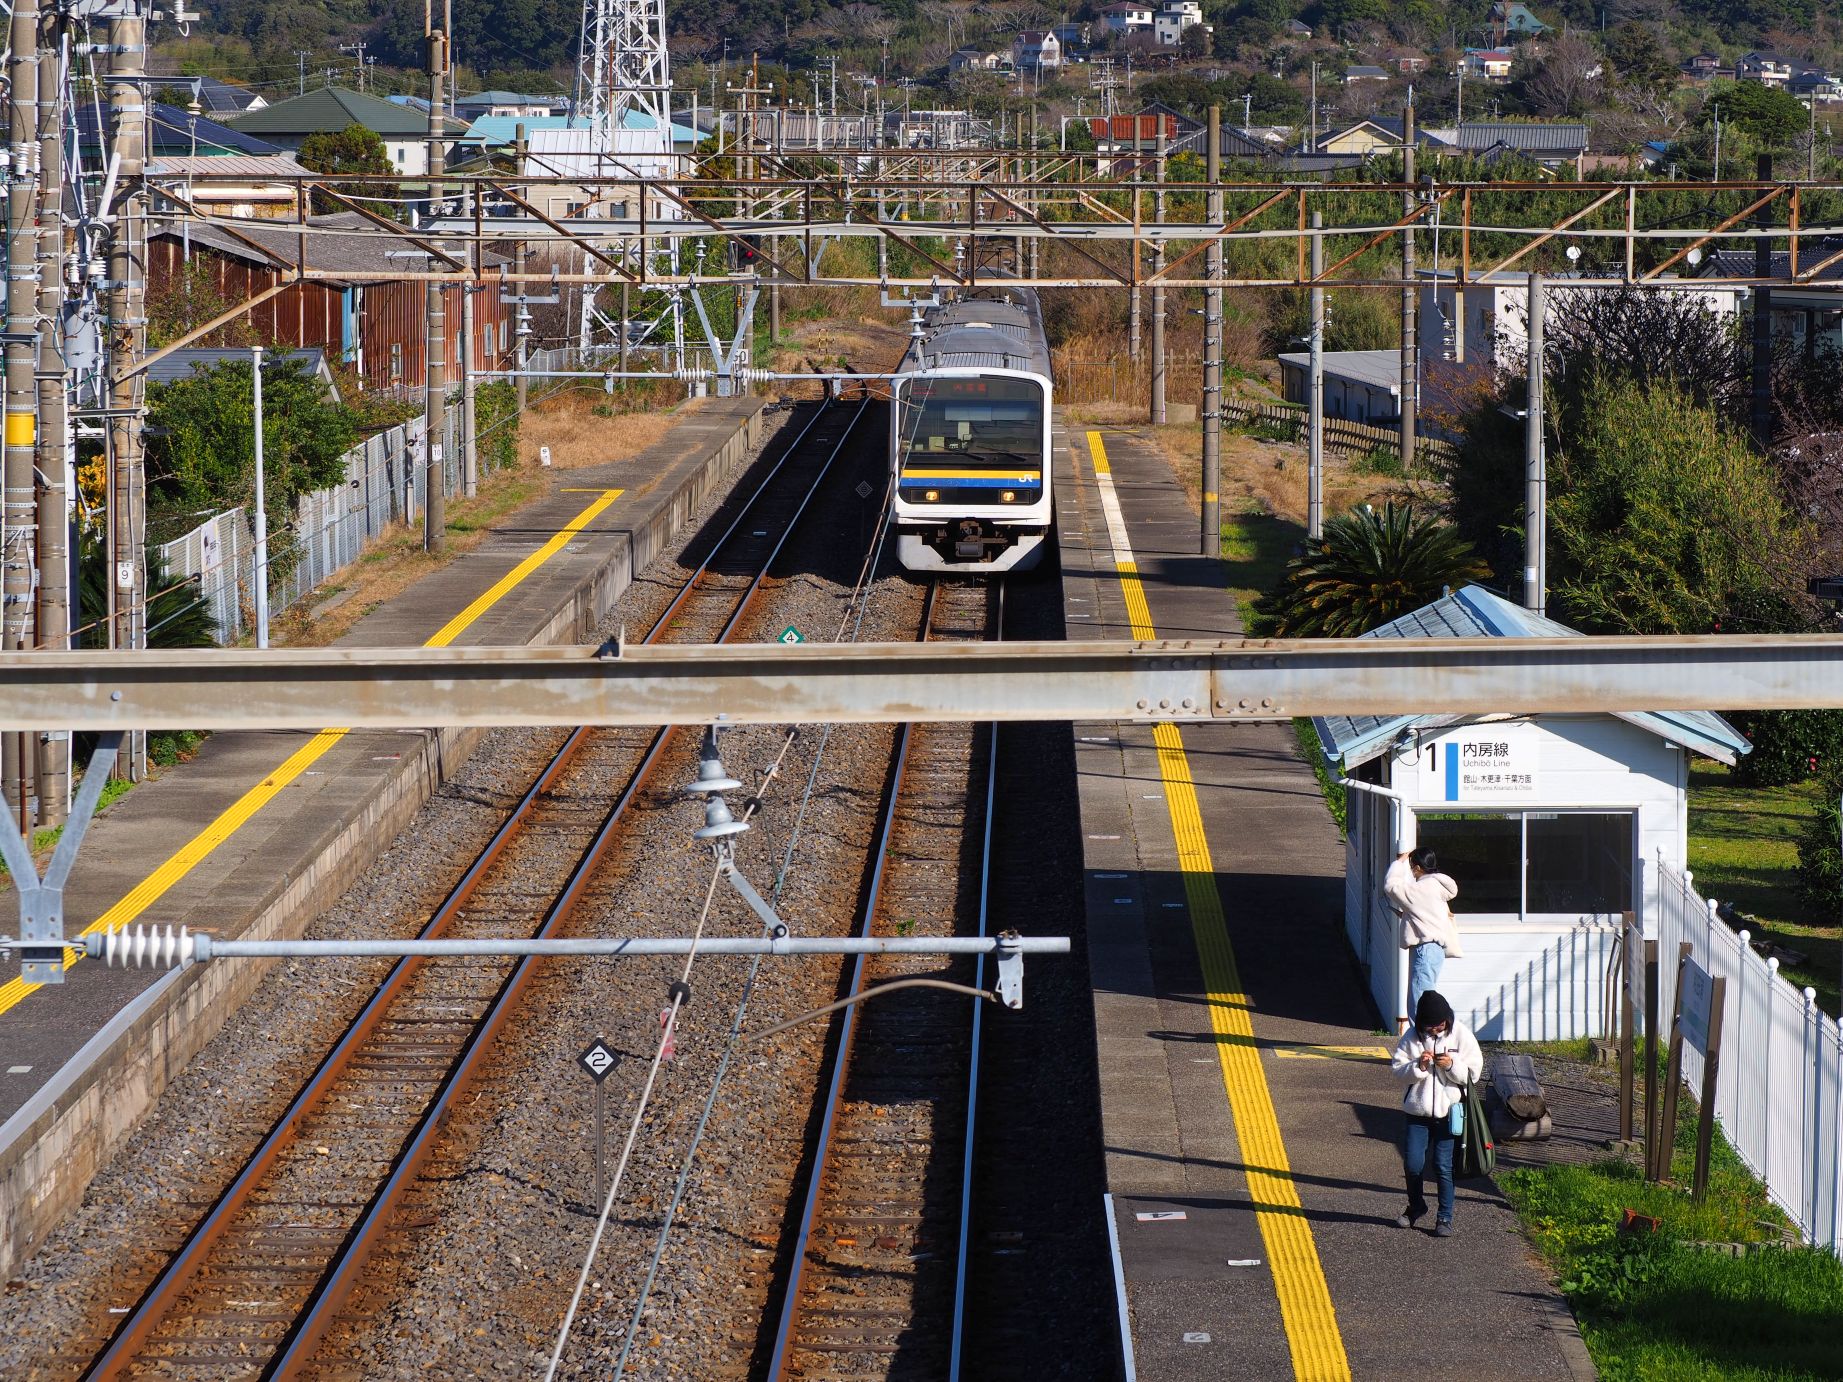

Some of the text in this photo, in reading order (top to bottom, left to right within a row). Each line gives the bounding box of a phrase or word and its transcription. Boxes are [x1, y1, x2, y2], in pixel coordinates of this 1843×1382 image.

[1018, 473, 1033, 483] JR
[121, 569, 129, 580] 9
[786, 631, 794, 643] 4
[1463, 742, 1509, 758] 内房線
[1425, 742, 1436, 772] 1
[1493, 759, 1511, 768] Line
[591, 1051, 607, 1067] 2
